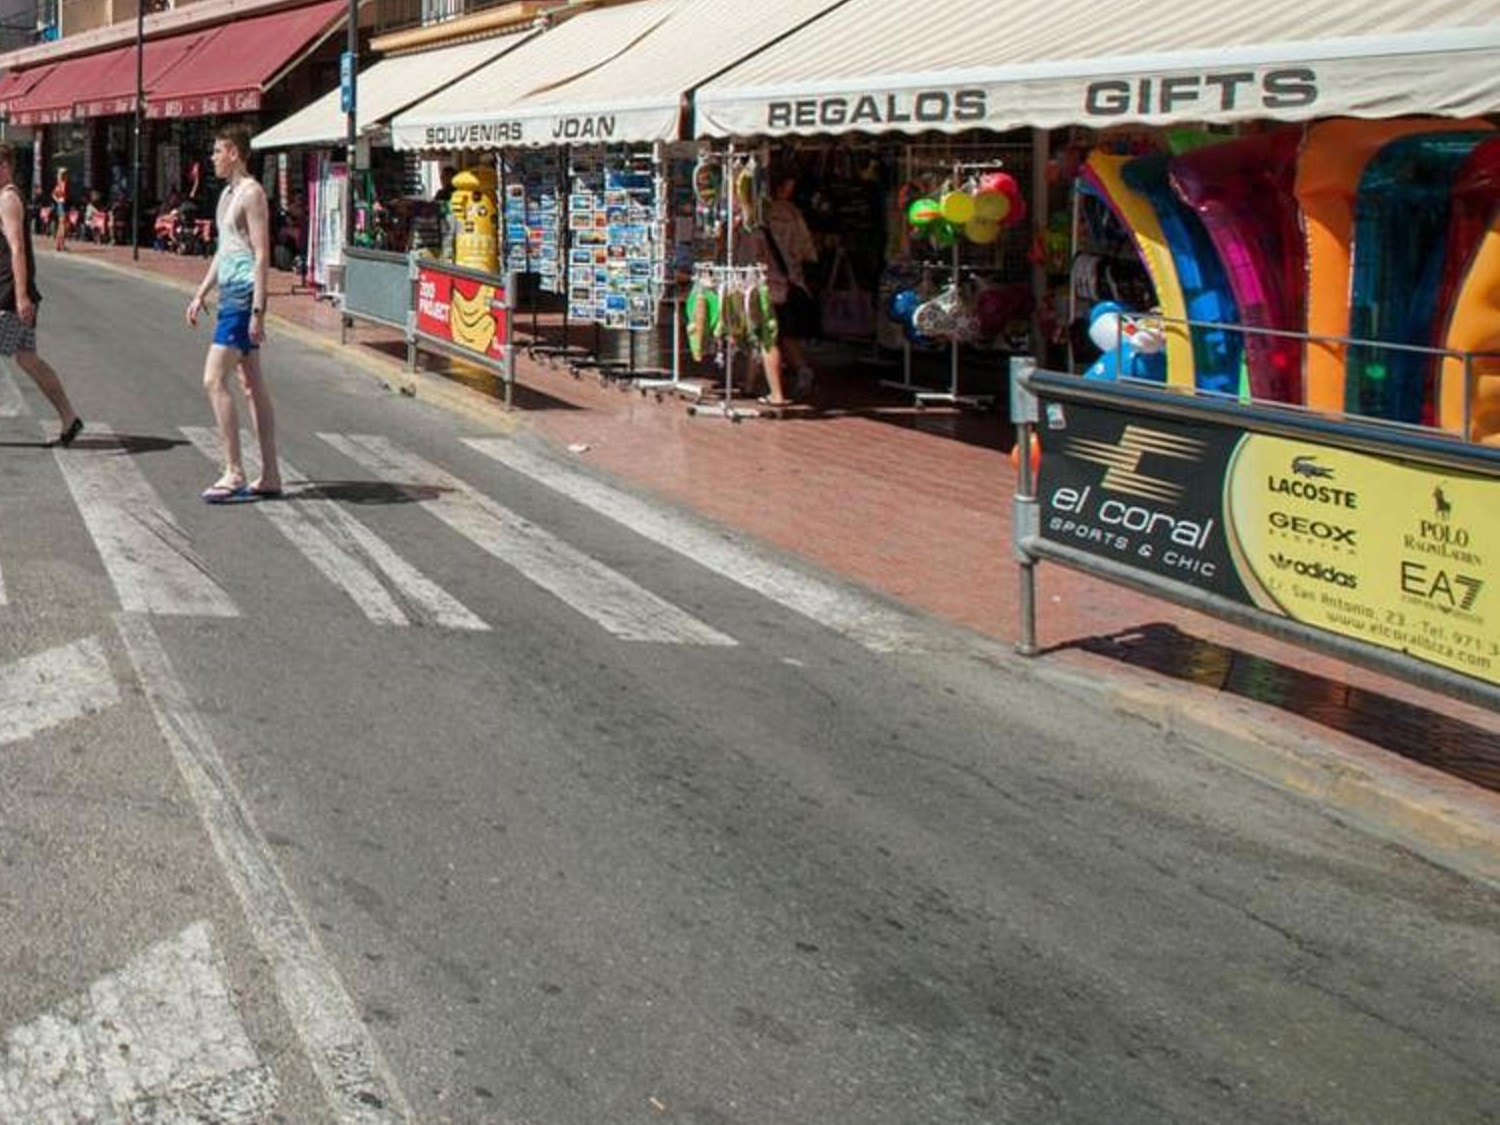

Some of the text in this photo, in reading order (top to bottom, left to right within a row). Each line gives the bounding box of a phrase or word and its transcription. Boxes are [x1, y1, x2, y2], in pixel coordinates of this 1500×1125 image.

[767, 68, 1318, 128] REGALOS GIFTS
[426, 116, 615, 144] SOUVENIRS JOAN
[1268, 476, 1358, 510] LACOSTE
[1052, 486, 1213, 551] el coral
[1268, 511, 1358, 546] GEOX
[1420, 520, 1469, 548] POLO
[1050, 517, 1217, 577] SPORTS & CHIC
[1293, 560, 1358, 589] adidas
[1401, 560, 1485, 611] EA7
